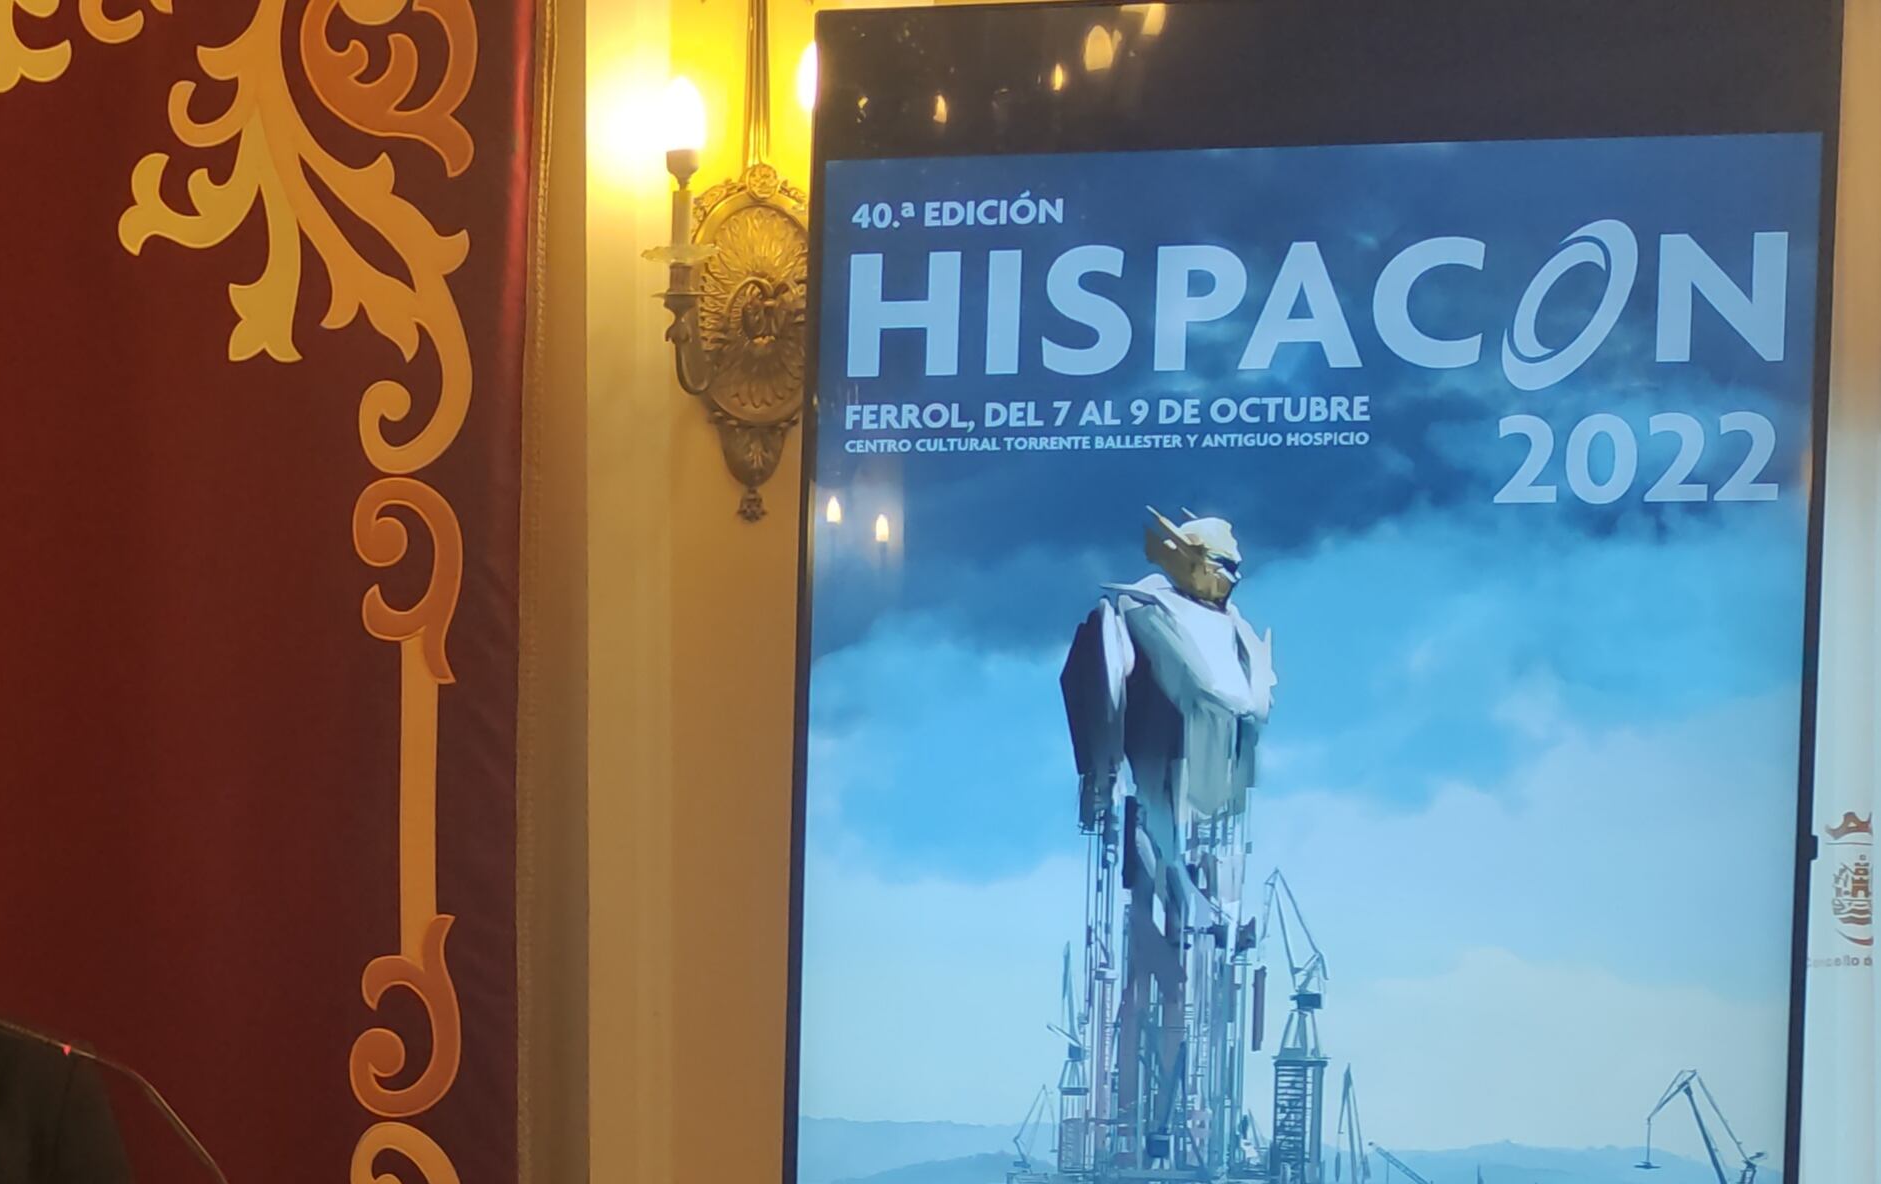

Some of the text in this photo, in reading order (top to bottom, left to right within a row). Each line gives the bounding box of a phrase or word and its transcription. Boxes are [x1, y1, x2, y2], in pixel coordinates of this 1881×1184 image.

[923, 190, 1063, 227] EDICIÓN
[845, 218, 1789, 391] HISPACON
[845, 395, 1371, 433] FERROL, DEL 7 AL 9 DE OCTUBRE
[845, 431, 1370, 453] CENTRO CULTURAL TORRENTE BALLESTER Y ANTIGUO HOSPICIO
[1492, 411, 1780, 506] 2022
